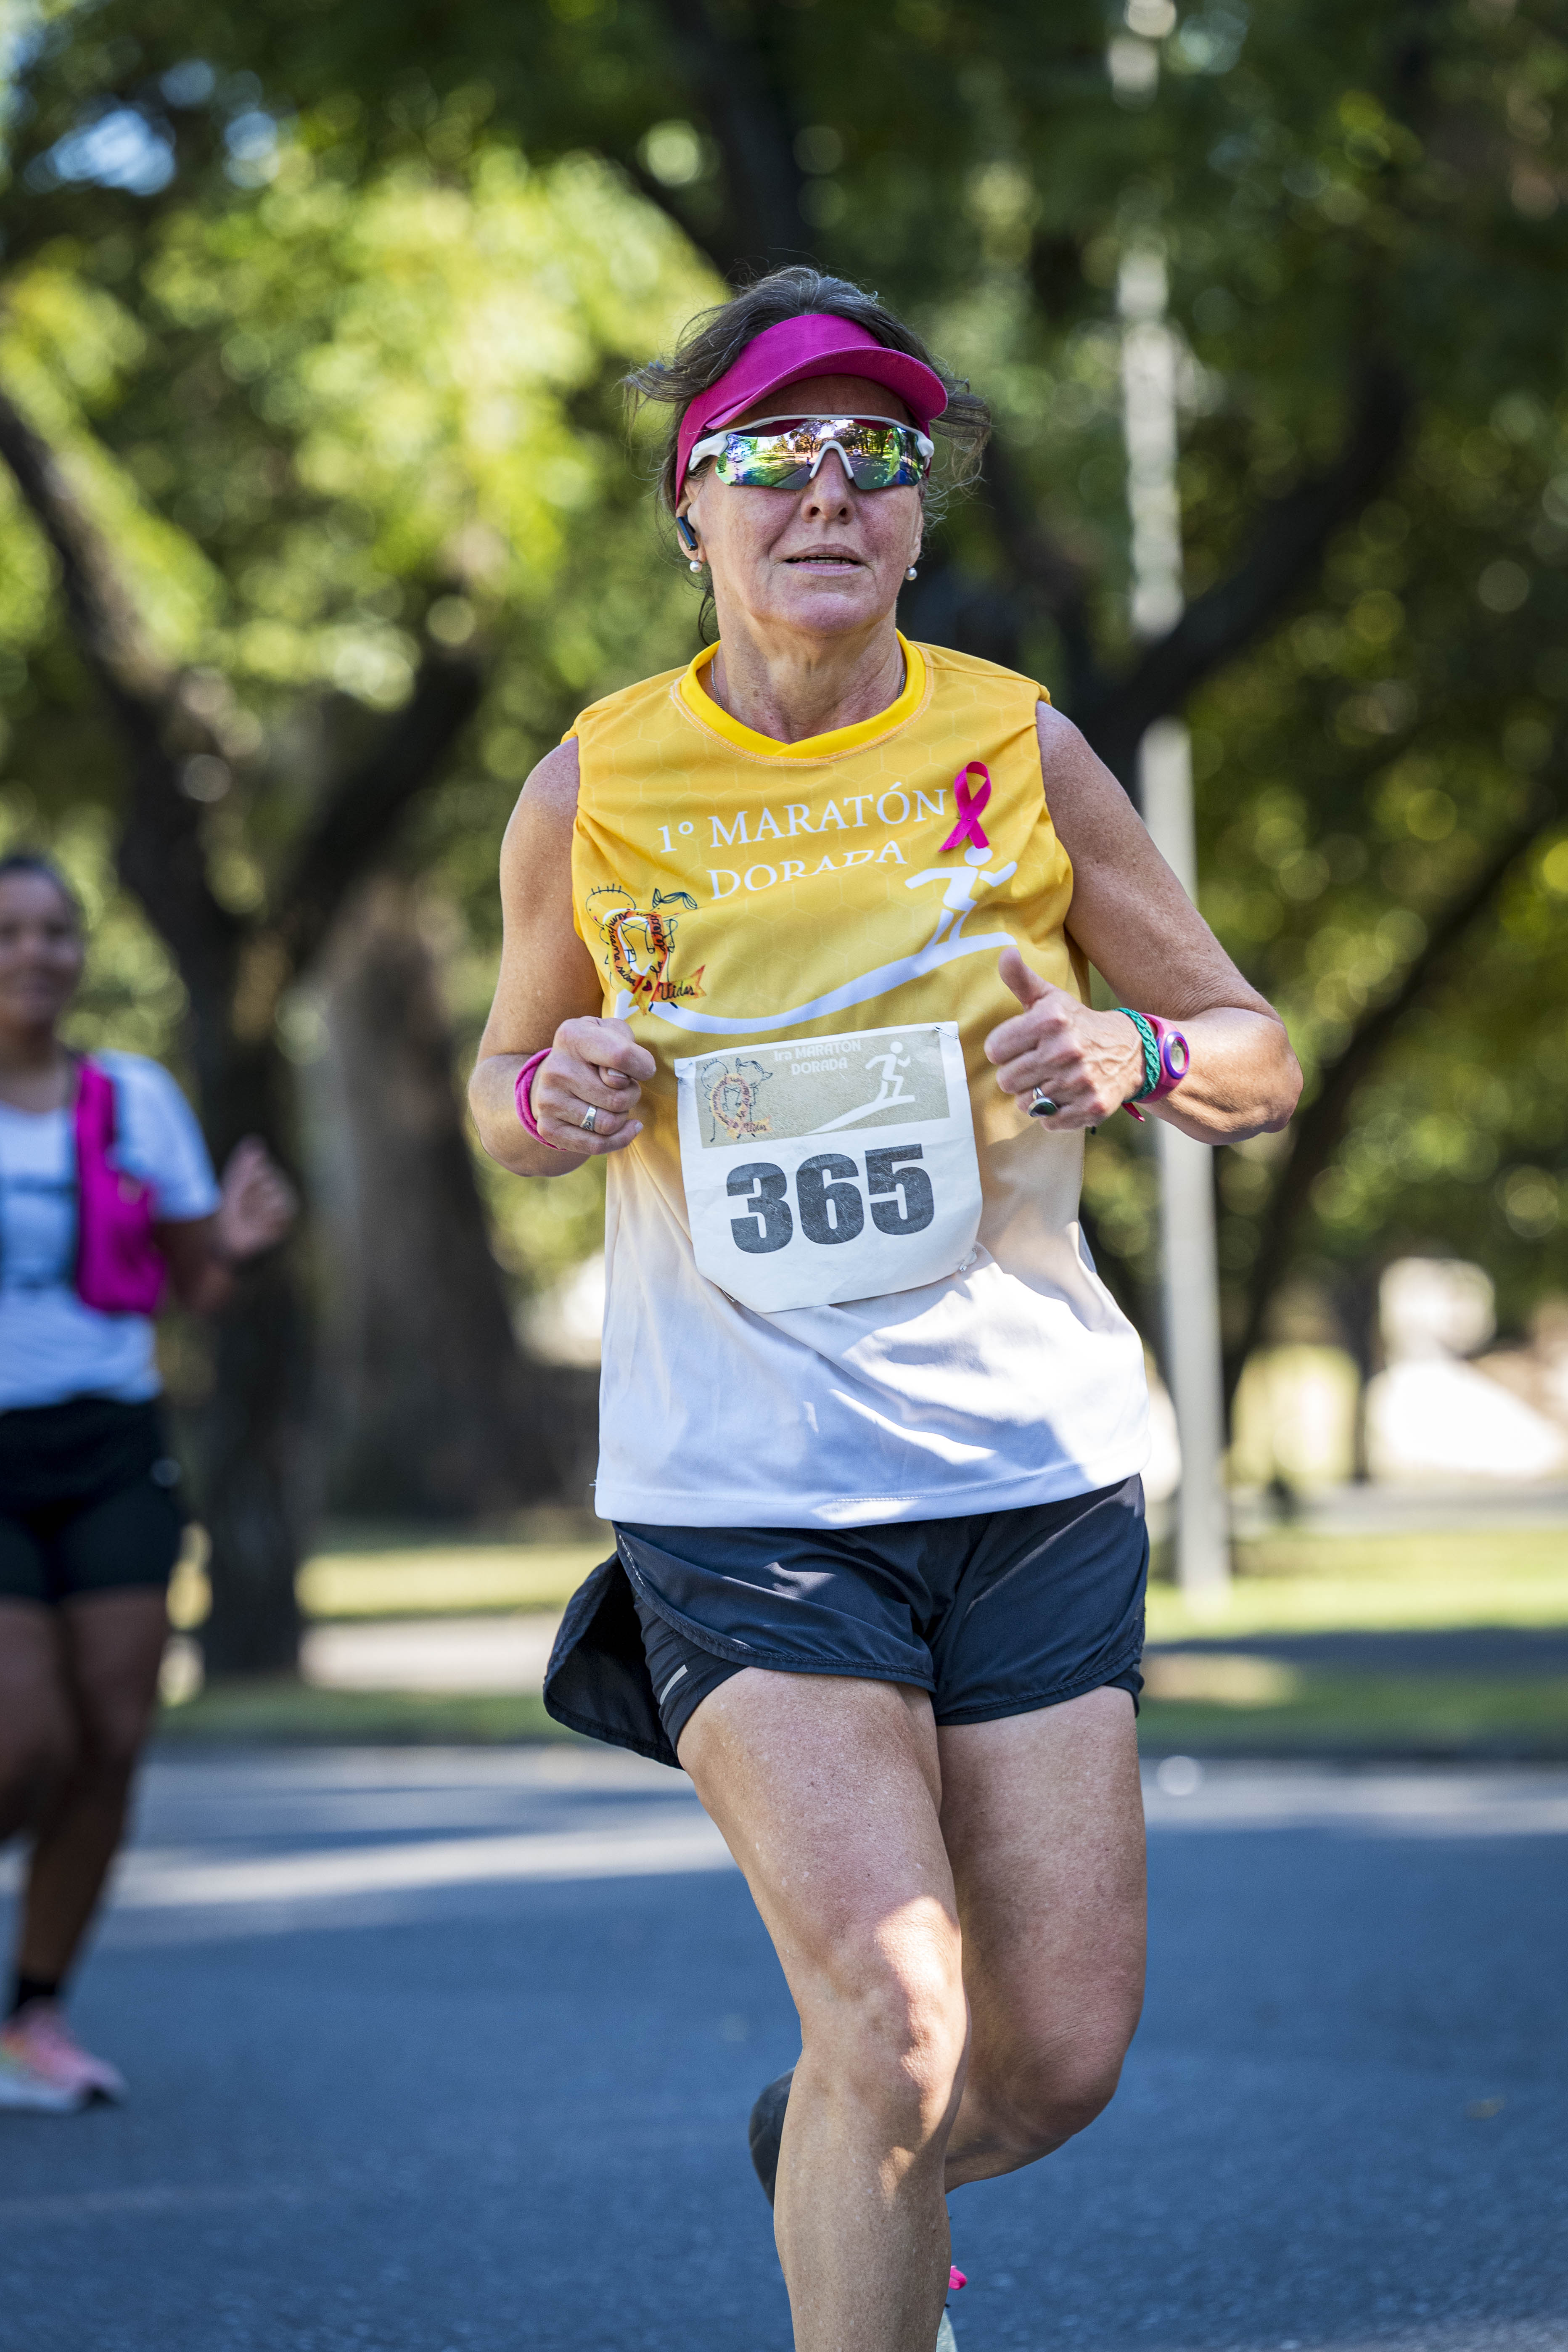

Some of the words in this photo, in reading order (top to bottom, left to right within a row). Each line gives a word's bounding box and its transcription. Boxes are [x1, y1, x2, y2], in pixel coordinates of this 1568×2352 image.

[708, 781, 947, 848] MARATÓN
[706, 840, 908, 900] DORADA
[605, 911, 630, 962] temprana
[791, 1056, 848, 1075] DORADA
[727, 1144, 934, 1253] 365
